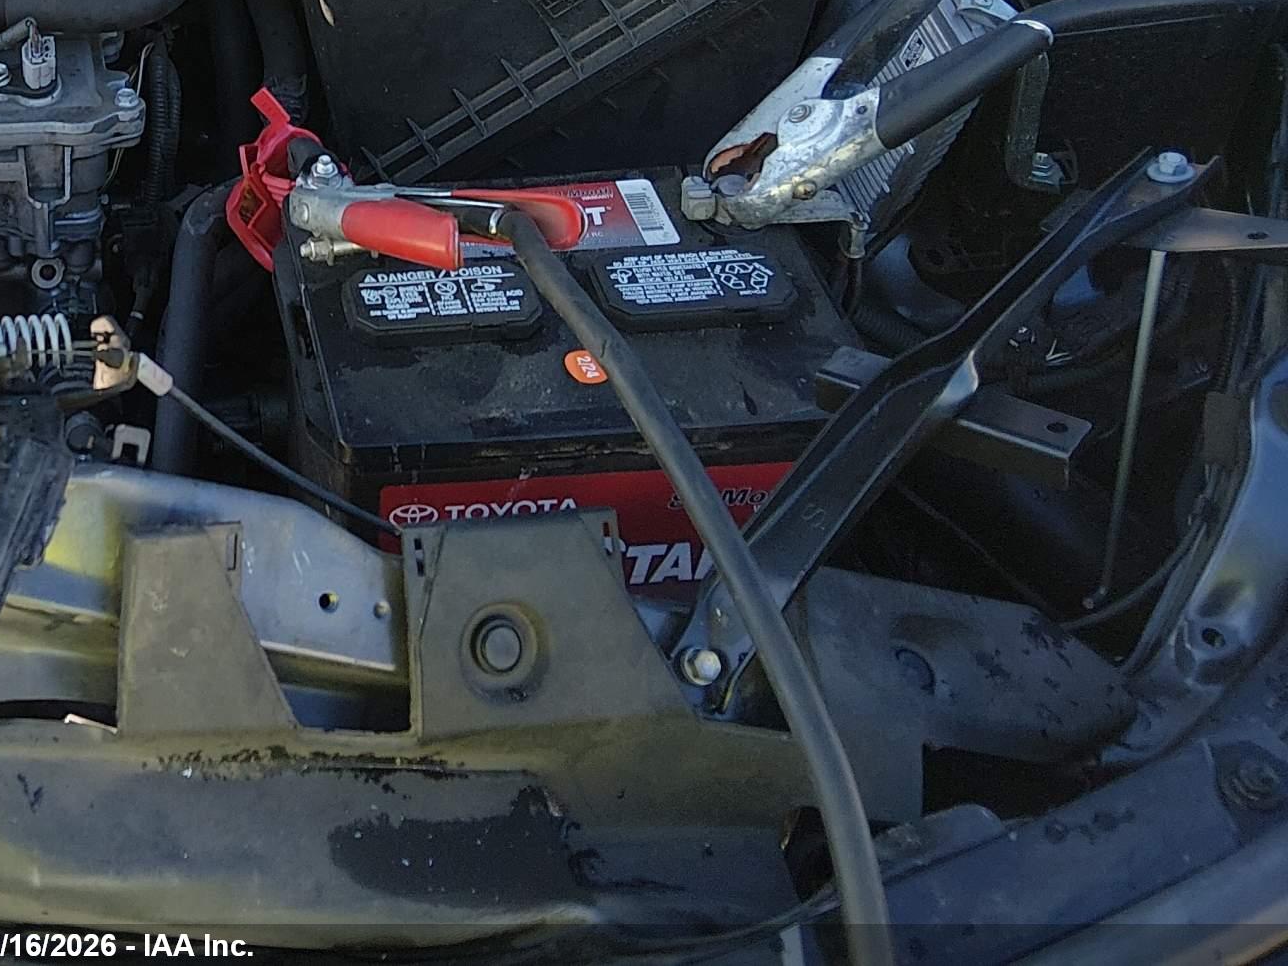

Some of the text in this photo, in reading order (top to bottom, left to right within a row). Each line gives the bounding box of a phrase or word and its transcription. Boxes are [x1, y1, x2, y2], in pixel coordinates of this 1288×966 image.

[377, 270, 436, 283] DANGER
[450, 265, 503, 278] POISON
[577, 356, 601, 378] 2/24
[444, 497, 577, 522] TOYOTA
